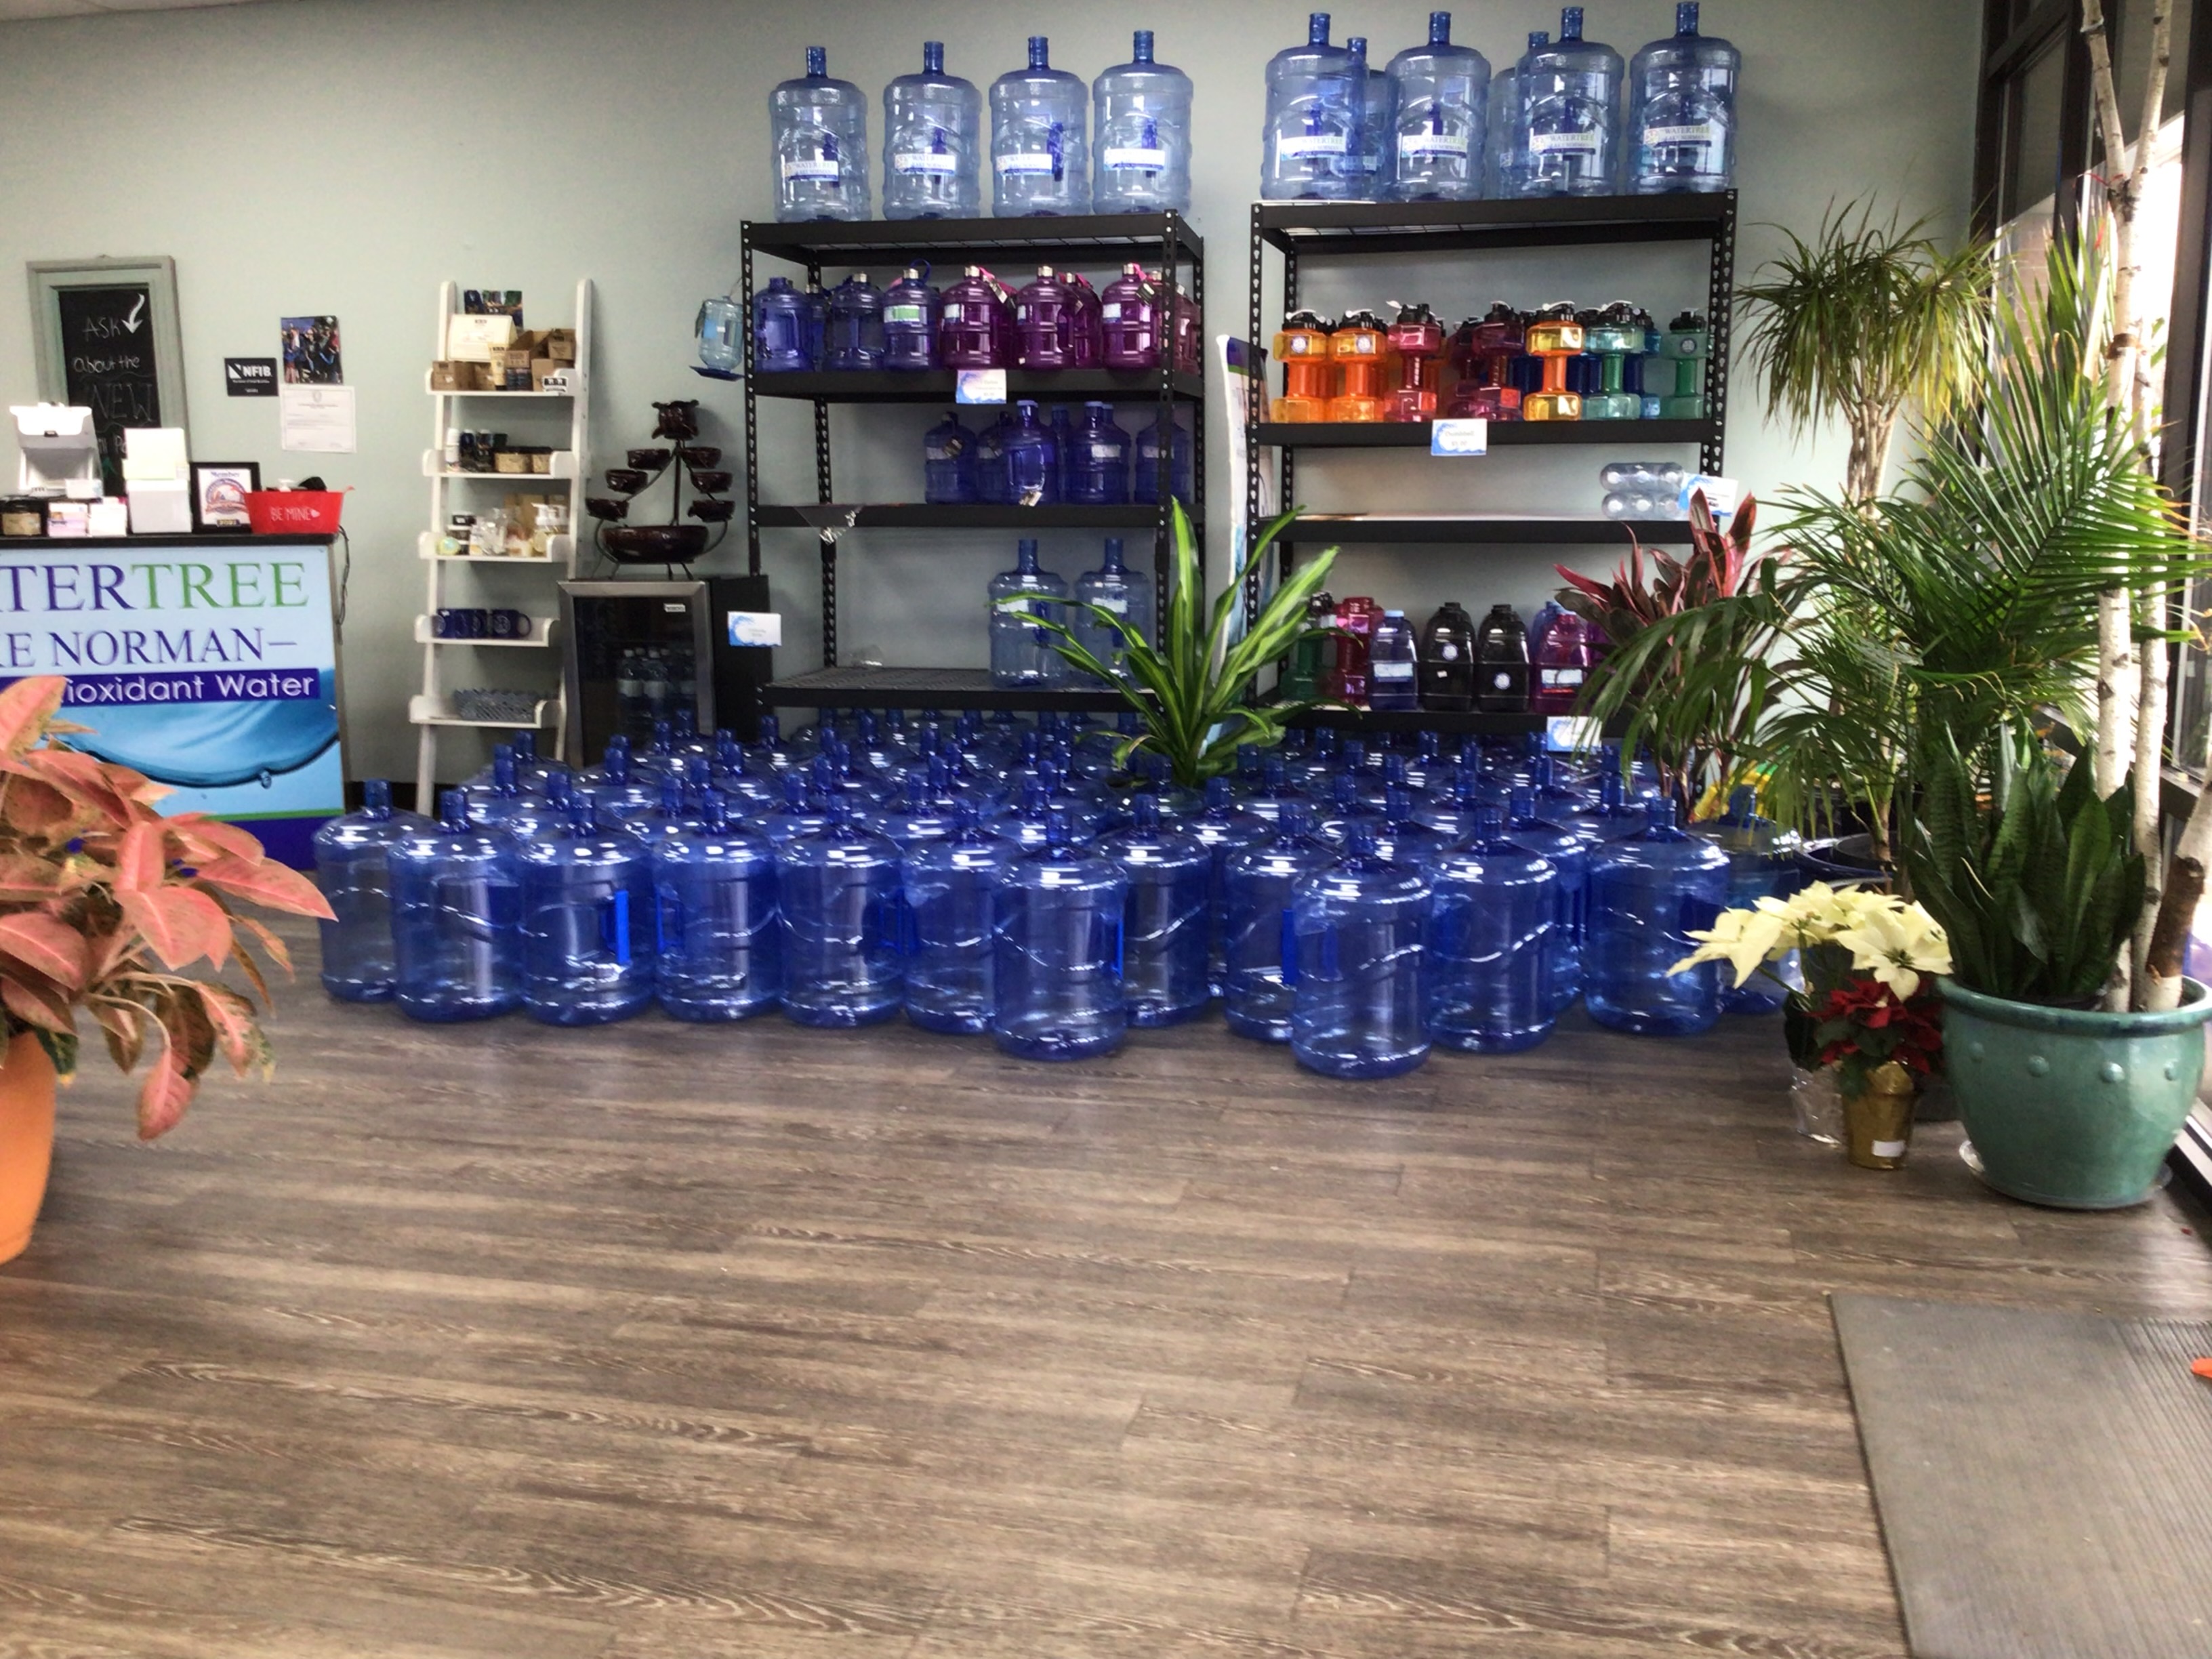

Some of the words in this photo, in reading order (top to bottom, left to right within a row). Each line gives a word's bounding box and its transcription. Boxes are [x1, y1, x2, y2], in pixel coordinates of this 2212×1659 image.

[73, 356, 116, 373] about
[118, 356, 141, 369] the
[243, 365, 272, 377] NFIB
[91, 383, 155, 422] NEW
[271, 508, 283, 521] BE
[285, 508, 311, 521] MINE
[0, 562, 310, 612] TERTREE
[62, 676, 205, 703] ioxidant
[215, 673, 315, 699] Water
